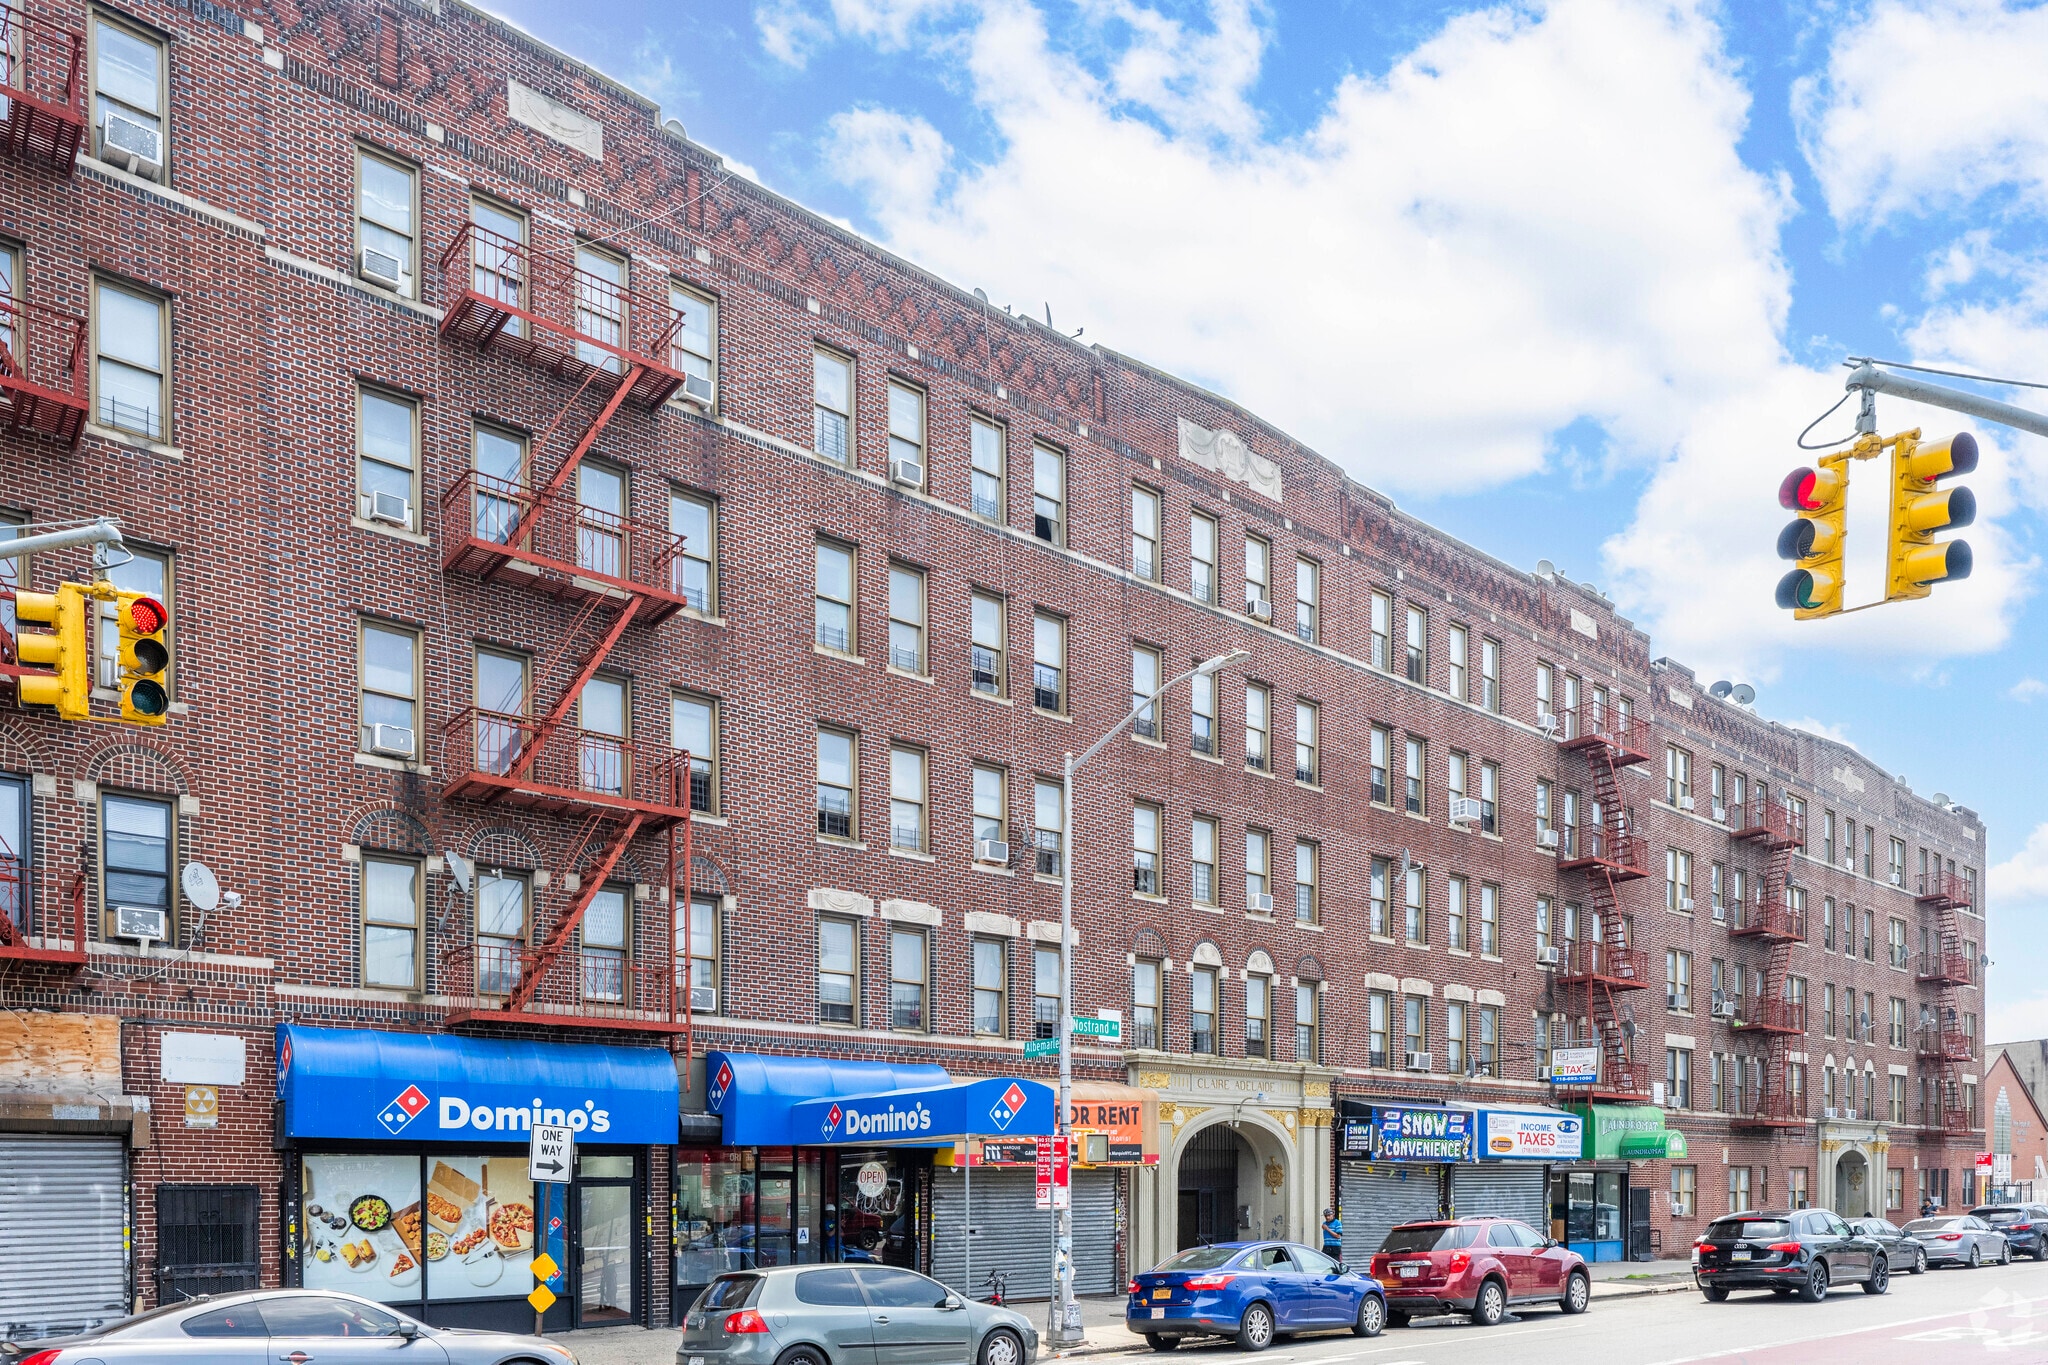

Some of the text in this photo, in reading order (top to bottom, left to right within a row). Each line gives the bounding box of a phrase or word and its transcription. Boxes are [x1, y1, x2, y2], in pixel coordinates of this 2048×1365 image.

[1073, 1018, 1109, 1034] Nostrand
[1025, 1039, 1059, 1053] Albemarle
[1565, 1065, 1582, 1074] TAX
[1197, 1078, 1275, 1093] CLAIRE ADELAIDE
[439, 1097, 610, 1132] Domino's
[845, 1101, 931, 1135] Domino's
[1055, 1105, 1140, 1125] FOR RENT
[1348, 1126, 1368, 1135] SNOW
[1402, 1113, 1448, 1136] SNOW
[1520, 1123, 1551, 1132] INCOME
[1602, 1119, 1659, 1136] LAUNDROMAT
[542, 1129, 563, 1142] ONE
[1517, 1132, 1555, 1146] TAXES
[541, 1144, 563, 1156] WAY
[1385, 1139, 1461, 1157] CONVENIENCE
[859, 1171, 885, 1184] OPEN
[799, 1229, 807, 1239] A
